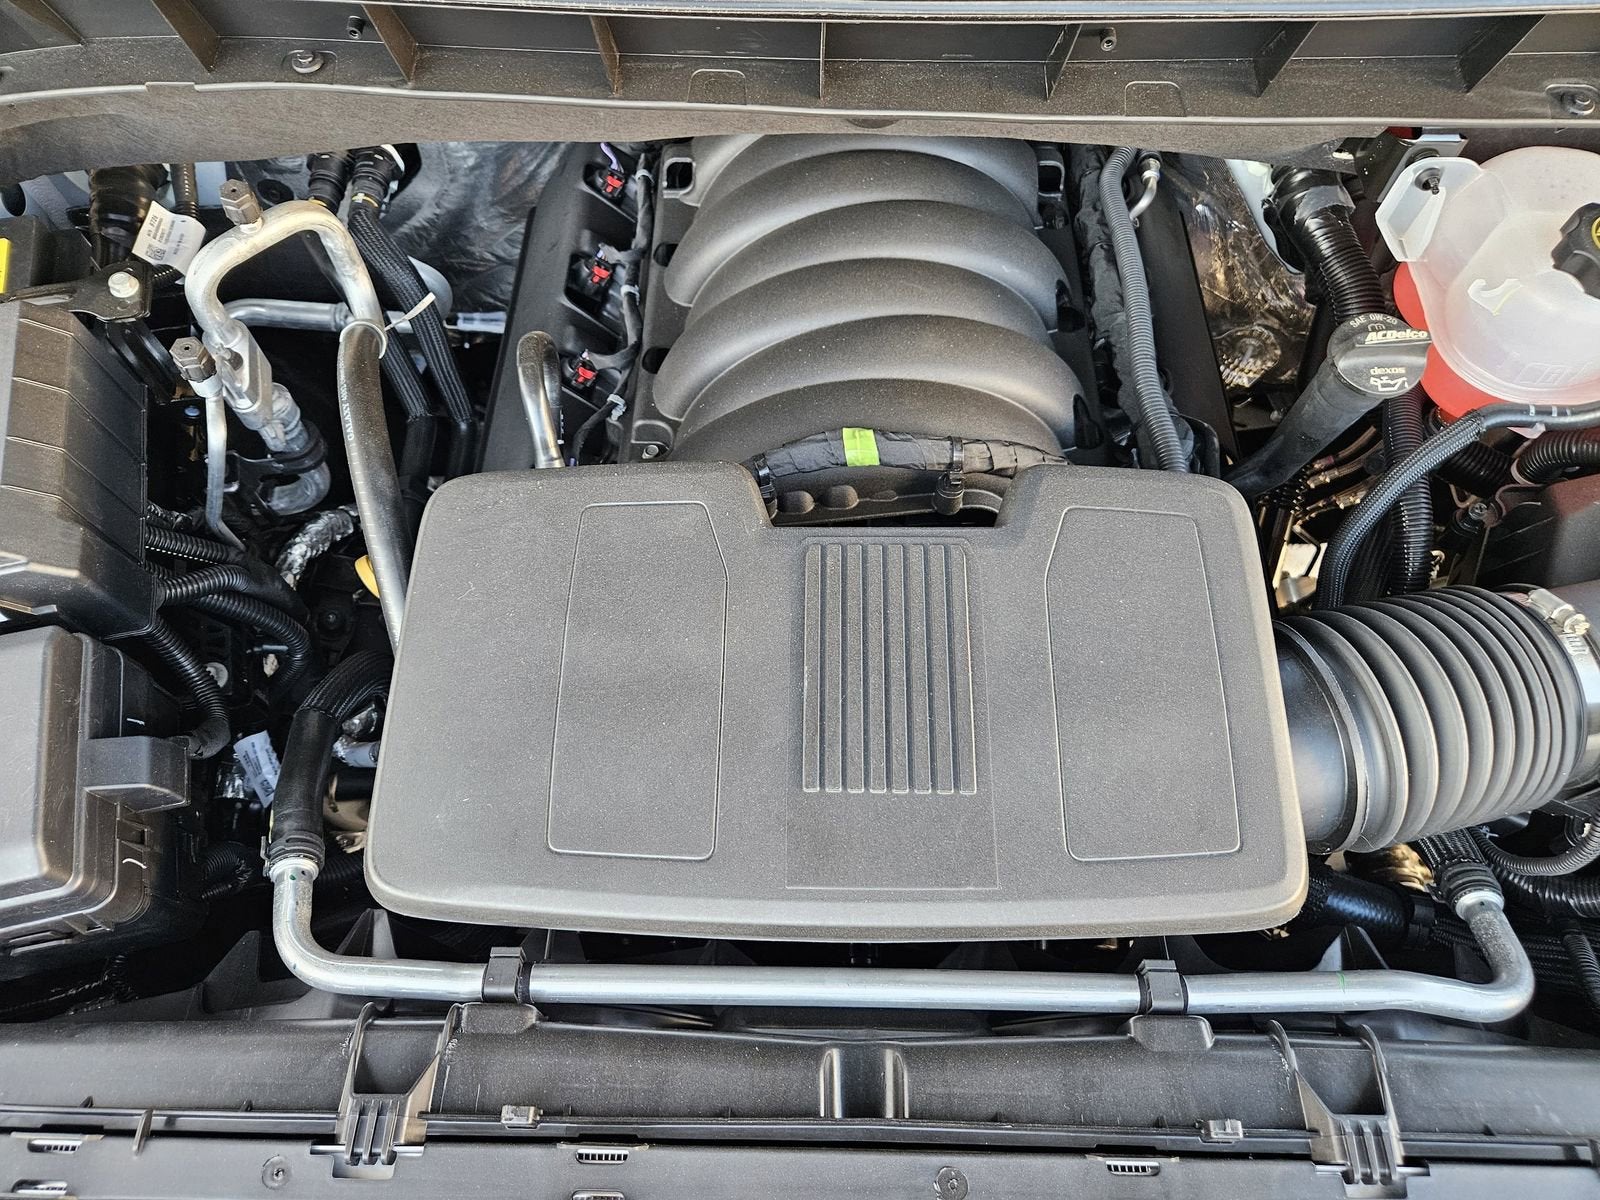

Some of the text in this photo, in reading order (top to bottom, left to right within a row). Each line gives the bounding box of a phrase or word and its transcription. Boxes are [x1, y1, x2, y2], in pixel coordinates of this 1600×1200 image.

[1349, 313, 1398, 328] SAE 0W-20
[1365, 329, 1428, 342] ACDelco
[1370, 367, 1406, 375] dexos
[342, 402, 354, 441] GALAXY
